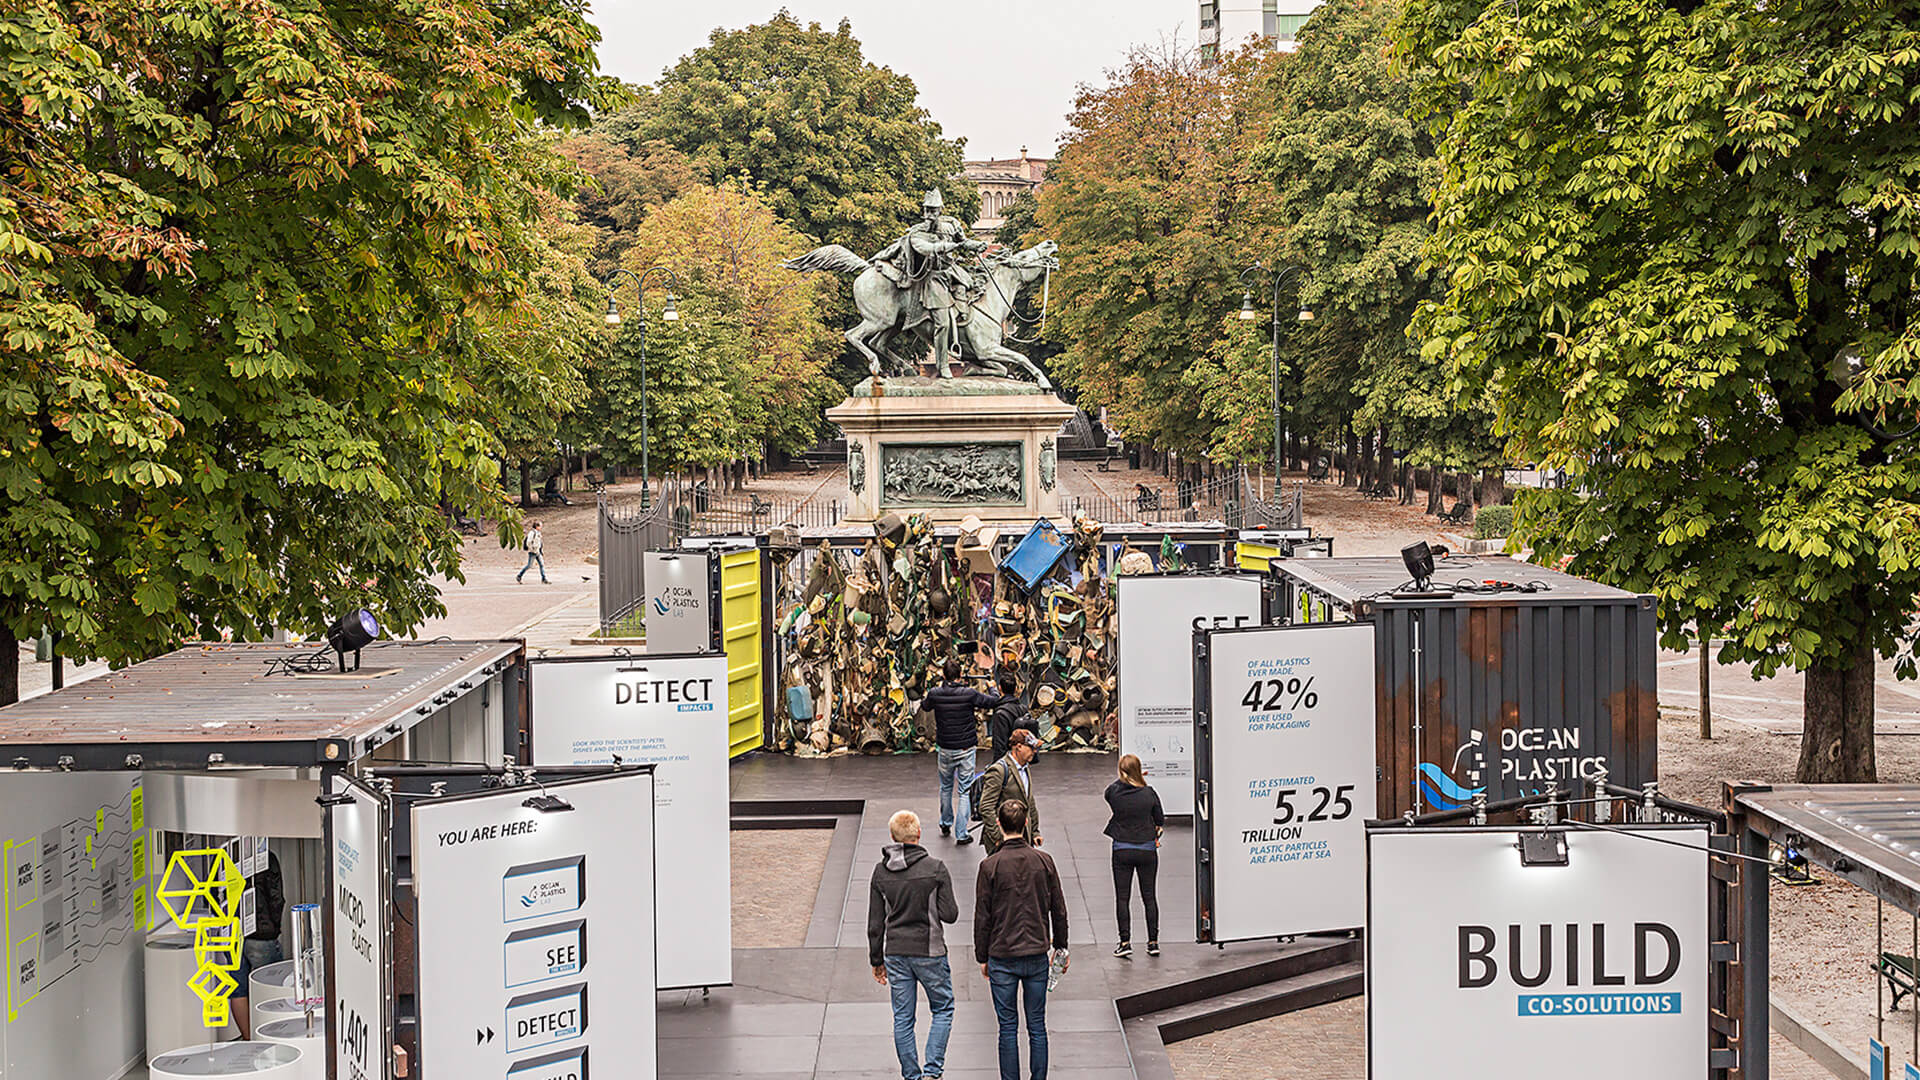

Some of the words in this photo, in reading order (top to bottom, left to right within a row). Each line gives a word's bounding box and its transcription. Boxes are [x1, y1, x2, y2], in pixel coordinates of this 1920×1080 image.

[673, 587, 692, 597] OCEAN
[673, 598, 699, 608] PLASTICS
[1247, 660, 1259, 669] OF
[1260, 660, 1273, 668] ALL
[1275, 657, 1311, 667] PLASTICS
[1247, 668, 1268, 677] EVER
[616, 679, 713, 705] DETECT
[1241, 676, 1318, 712] 42%
[1248, 714, 1270, 723] WERE
[1272, 712, 1292, 721] USED
[1248, 723, 1264, 731] FOR
[1265, 719, 1311, 730] PACKAGING
[1501, 728, 1579, 751] OCEAN
[1501, 756, 1608, 780] PLASTICS
[1248, 780, 1258, 788] IT
[1258, 779, 1267, 788] IS
[1268, 776, 1315, 787] ESTIMATED
[1249, 789, 1271, 798] THAT
[1273, 785, 1354, 825] 5.25
[438, 829, 468, 847] YOU
[470, 825, 498, 842] ARE
[500, 820, 538, 837] HERE:
[1242, 827, 1302, 843] TRILLION
[1249, 844, 1284, 855] PLASTIC
[1285, 840, 1328, 852] PARTICLES
[1249, 855, 1267, 864] ARE
[1268, 852, 1301, 863] AFLOAT
[1302, 851, 1314, 860] AT
[1315, 849, 1331, 859] SEA
[540, 887, 566, 897] PLASTICS
[338, 883, 366, 928] MICRO-
[351, 928, 372, 963] PLASTIC
[1458, 922, 1682, 988] BUILD
[546, 945, 576, 967] SEE
[1527, 995, 1672, 1014] CO-SOLUTIONS
[517, 1008, 577, 1038] DETECT
[339, 999, 368, 1071] 1,401
